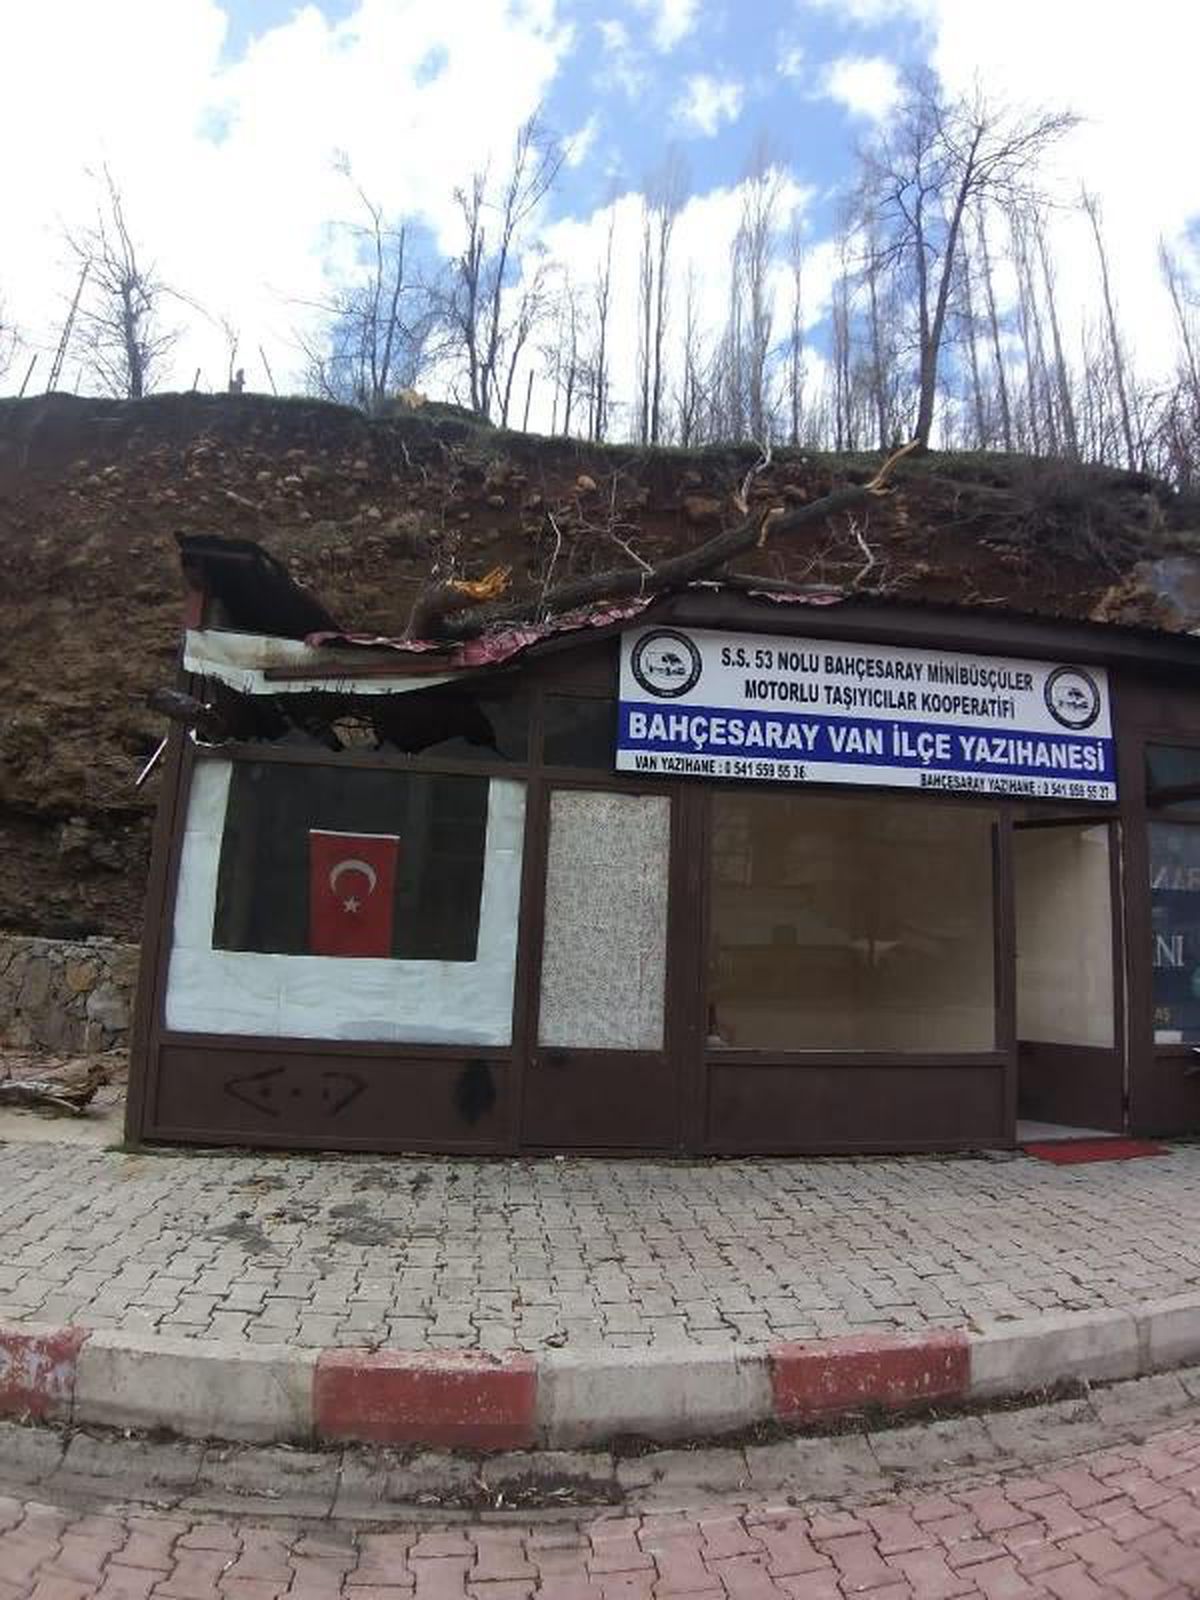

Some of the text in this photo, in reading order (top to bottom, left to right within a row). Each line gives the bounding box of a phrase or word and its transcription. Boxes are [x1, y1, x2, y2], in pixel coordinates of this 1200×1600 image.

[721, 647, 750, 669] S.S.
[755, 649, 773, 669] 53
[778, 651, 819, 675] NOLU
[825, 654, 924, 682] BAHÇESARAY
[745, 680, 820, 703] MOTORLU
[824, 684, 917, 711] TAŞIYICILAR
[921, 692, 1016, 719] KOOPERATİFİ
[629, 711, 1105, 772] BAHÇESARAY VAN İLÇE YAZIHANESİ
[635, 755, 657, 769] VAN
[661, 758, 715, 774] YAZIHANE
[734, 761, 753, 776] 541
[756, 763, 775, 777] 559
[777, 764, 791, 778] 55
[920, 773, 985, 792] BAHÇESARAY
[988, 777, 1036, 794] YAZIHANE
